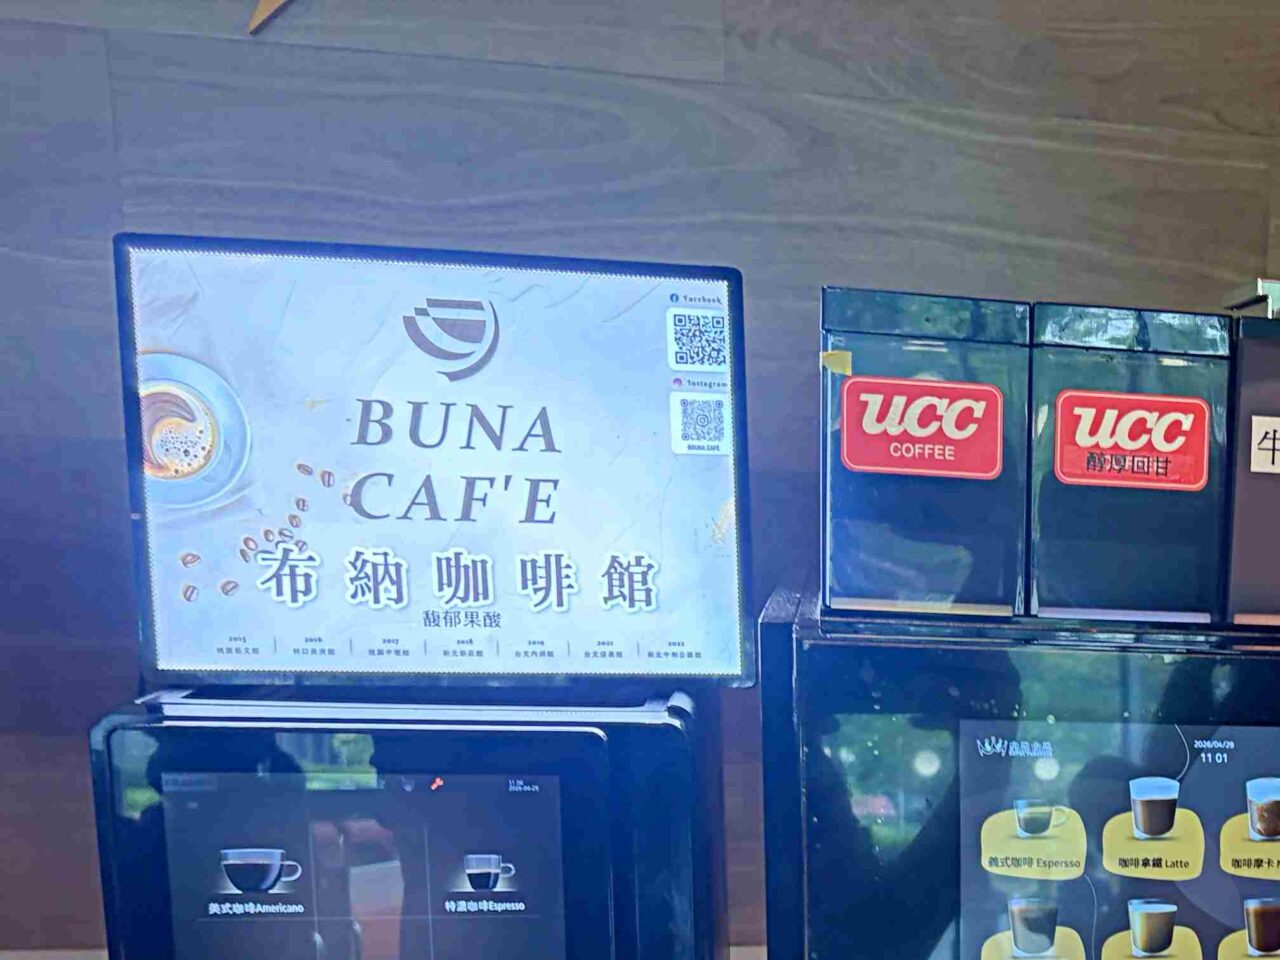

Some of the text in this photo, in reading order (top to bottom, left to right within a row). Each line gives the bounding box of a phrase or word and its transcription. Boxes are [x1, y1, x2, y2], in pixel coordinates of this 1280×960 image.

[350, 398, 562, 453] BUNA
[859, 392, 987, 441] UCC
[1073, 405, 1196, 453] UCC
[889, 442, 956, 461] COFFEE
[258, 548, 658, 609] 布納咖啡館
[422, 610, 502, 629] 馥郁果酸
[1165, 859, 1190, 869] Latte
